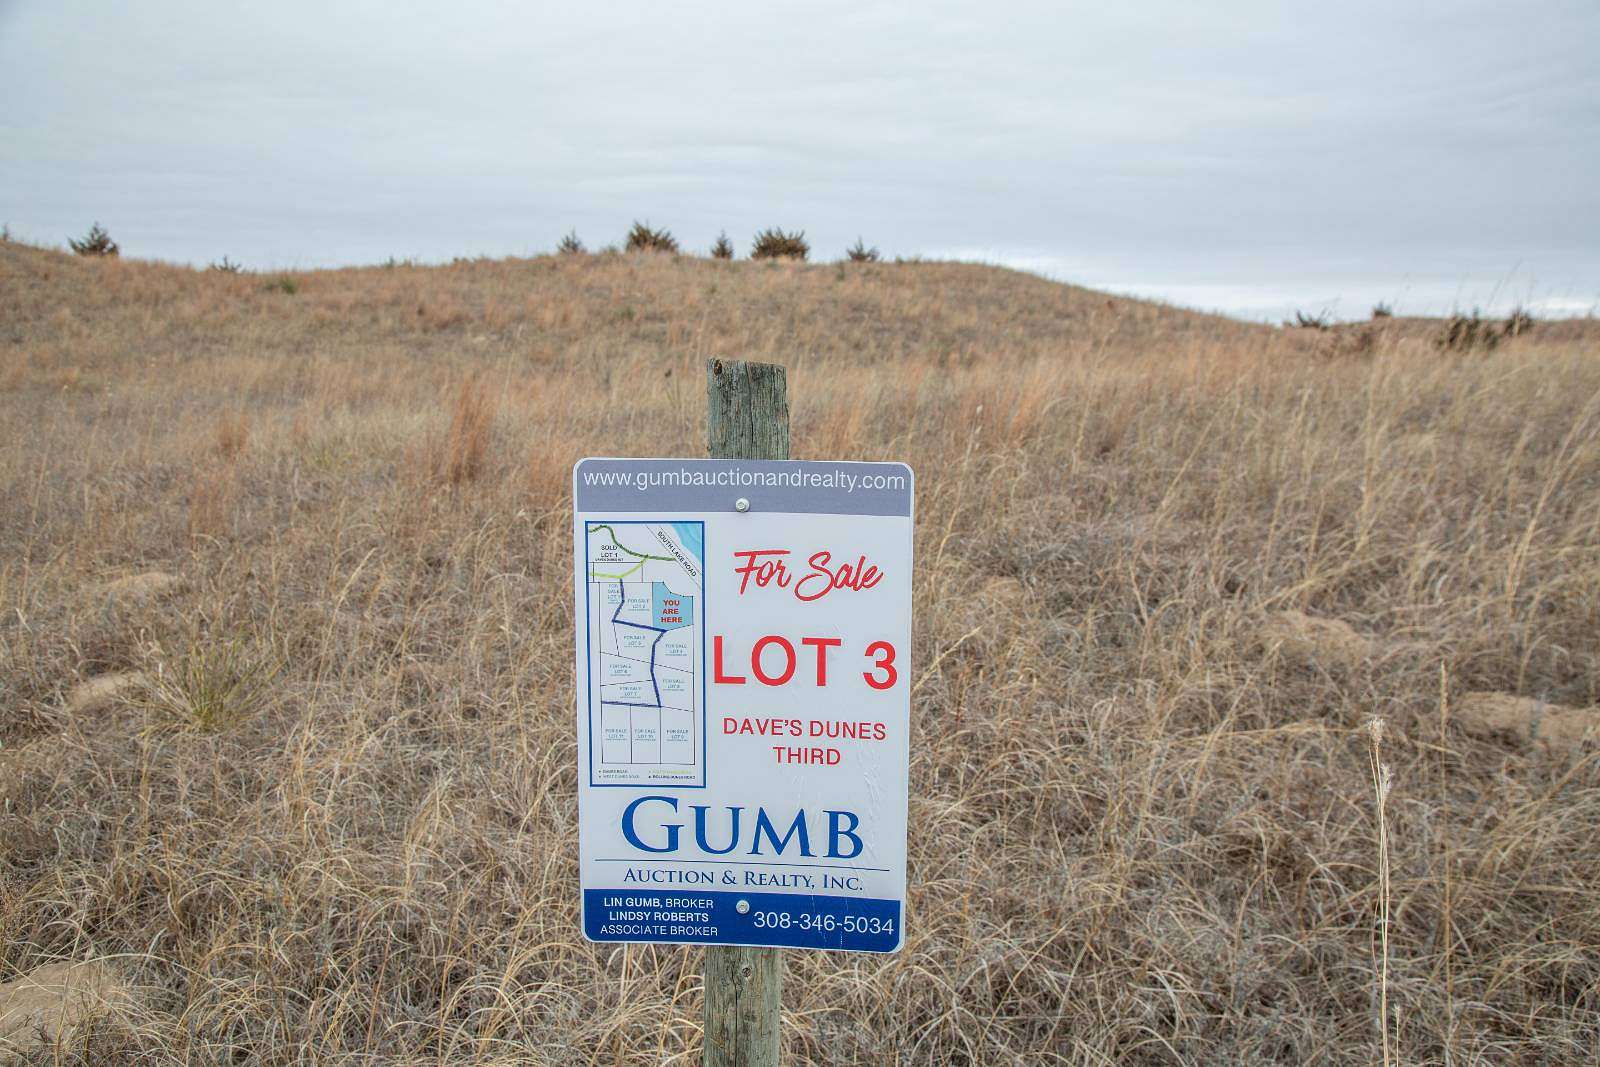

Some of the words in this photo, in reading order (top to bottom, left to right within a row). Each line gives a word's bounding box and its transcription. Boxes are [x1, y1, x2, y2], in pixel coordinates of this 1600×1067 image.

[583, 467, 905, 493] www.gumbauctionandrealty.com
[657, 531, 674, 550] SOUTH
[672, 548, 685, 562] LAKE
[682, 561, 697, 577] ROAD
[734, 549, 792, 595] For
[794, 551, 884, 602] Sale
[713, 635, 842, 687] LOT
[862, 640, 898, 690] 3
[723, 717, 803, 736] DAVE'S
[809, 720, 886, 740] DUNES
[772, 746, 841, 765] THIRD
[621, 795, 864, 859] GUMB
[624, 867, 714, 884] AUCTION
[721, 870, 737, 885] &
[604, 897, 622, 907] LIN
[625, 898, 663, 908] GUMB,
[665, 898, 714, 909] BROKER
[609, 911, 651, 921] LINDSY
[654, 912, 710, 922] ROBERTS
[753, 911, 894, 936] 308-346-5034
[600, 924, 668, 935] ASSOCIATE
[670, 926, 718, 936] BROKER
